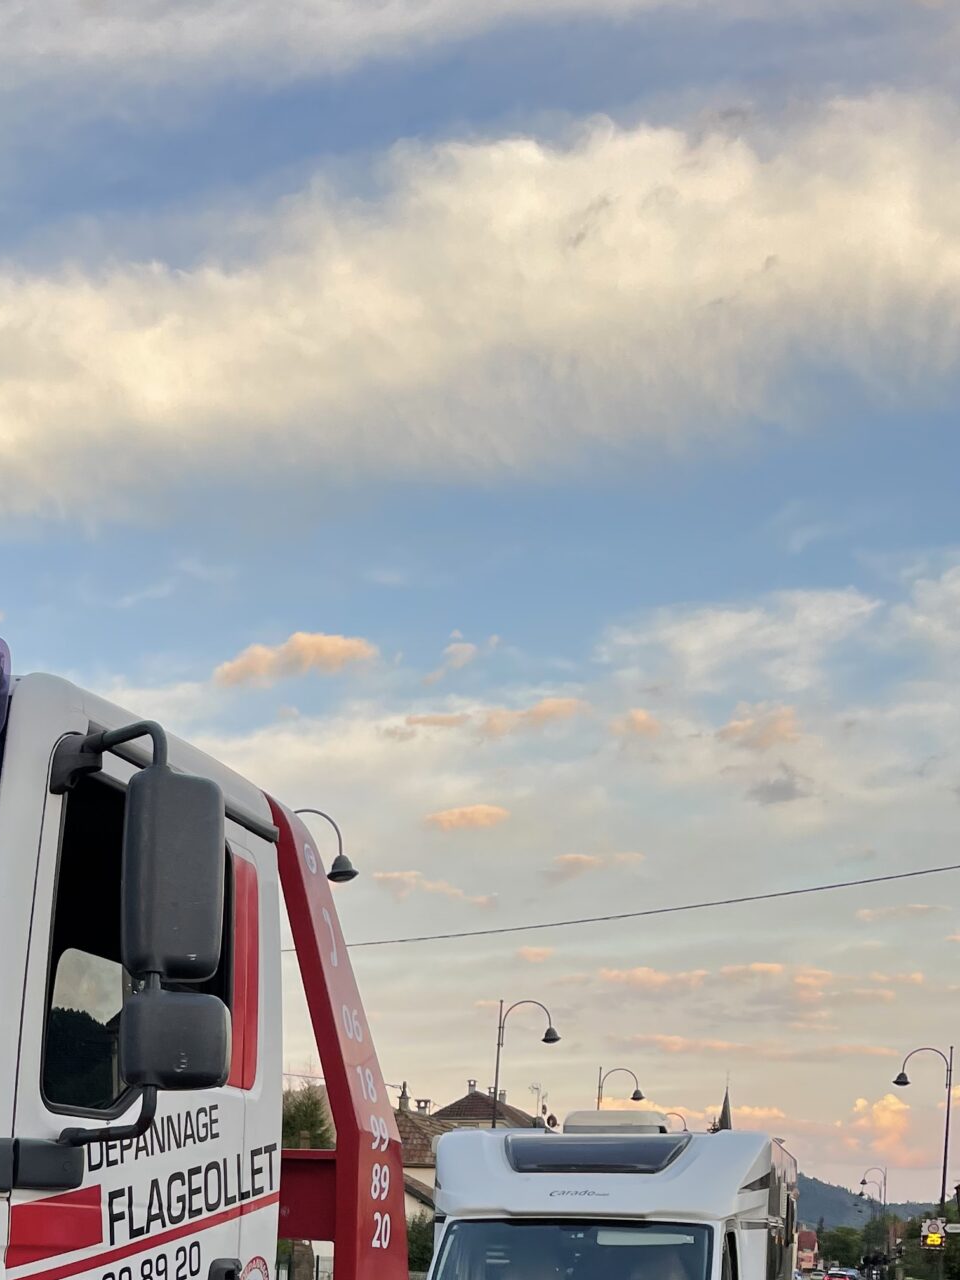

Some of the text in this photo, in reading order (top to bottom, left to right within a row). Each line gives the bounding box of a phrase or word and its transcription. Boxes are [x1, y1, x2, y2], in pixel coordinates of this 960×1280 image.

[342, 1004, 363, 1043] 06
[356, 1065, 377, 1103] 18
[370, 1115, 389, 1152] 99
[107, 1143, 278, 1247] FLAGEOLLET
[371, 1163, 390, 1200] 89
[371, 1212, 390, 1249] 20
